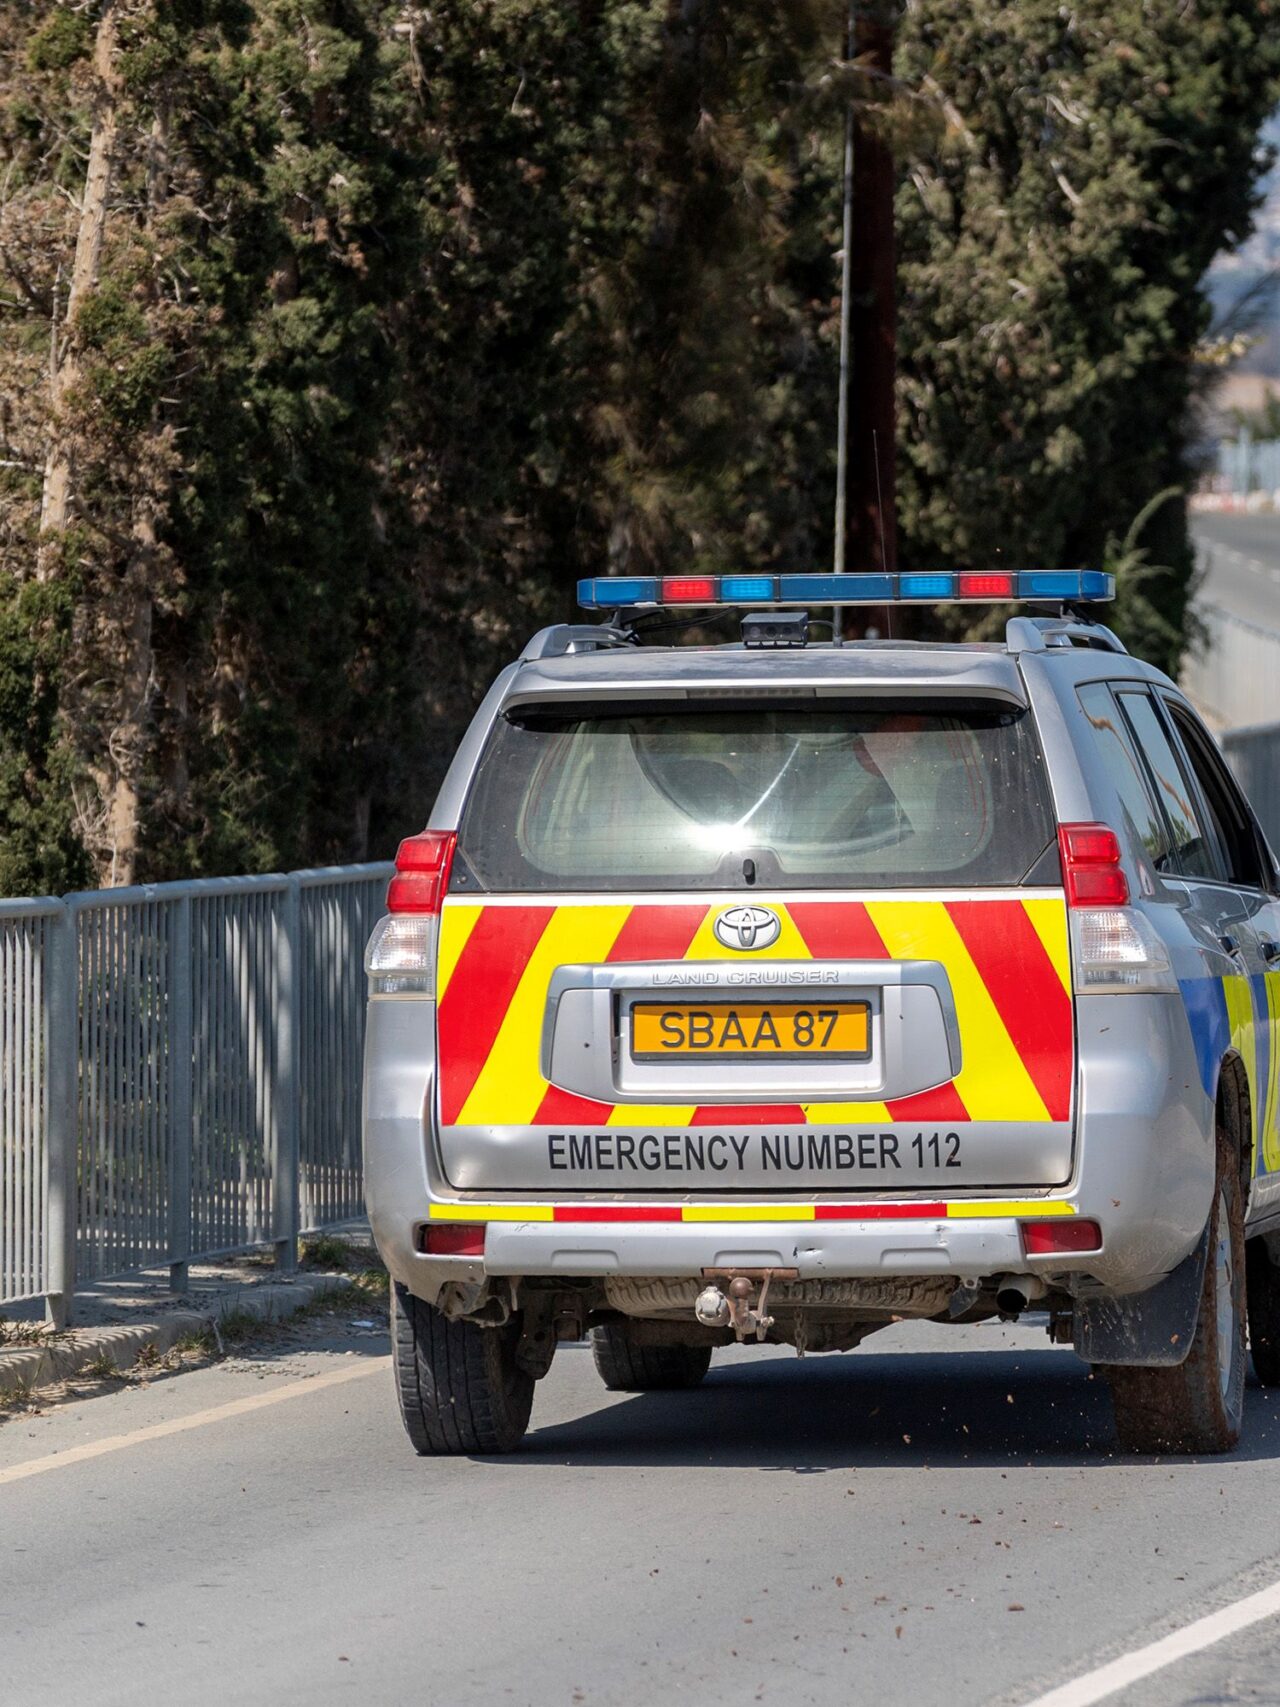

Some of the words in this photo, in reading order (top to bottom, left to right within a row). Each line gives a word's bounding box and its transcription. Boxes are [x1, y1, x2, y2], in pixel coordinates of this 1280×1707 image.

[652, 972, 719, 985] LAND
[726, 970, 840, 984] CRUISER
[659, 1010, 782, 1049] SBAA
[793, 1010, 839, 1048] 87
[548, 1135, 750, 1170] EMERGENCY
[761, 1134, 902, 1170] NUMBER
[911, 1132, 962, 1168] 112
